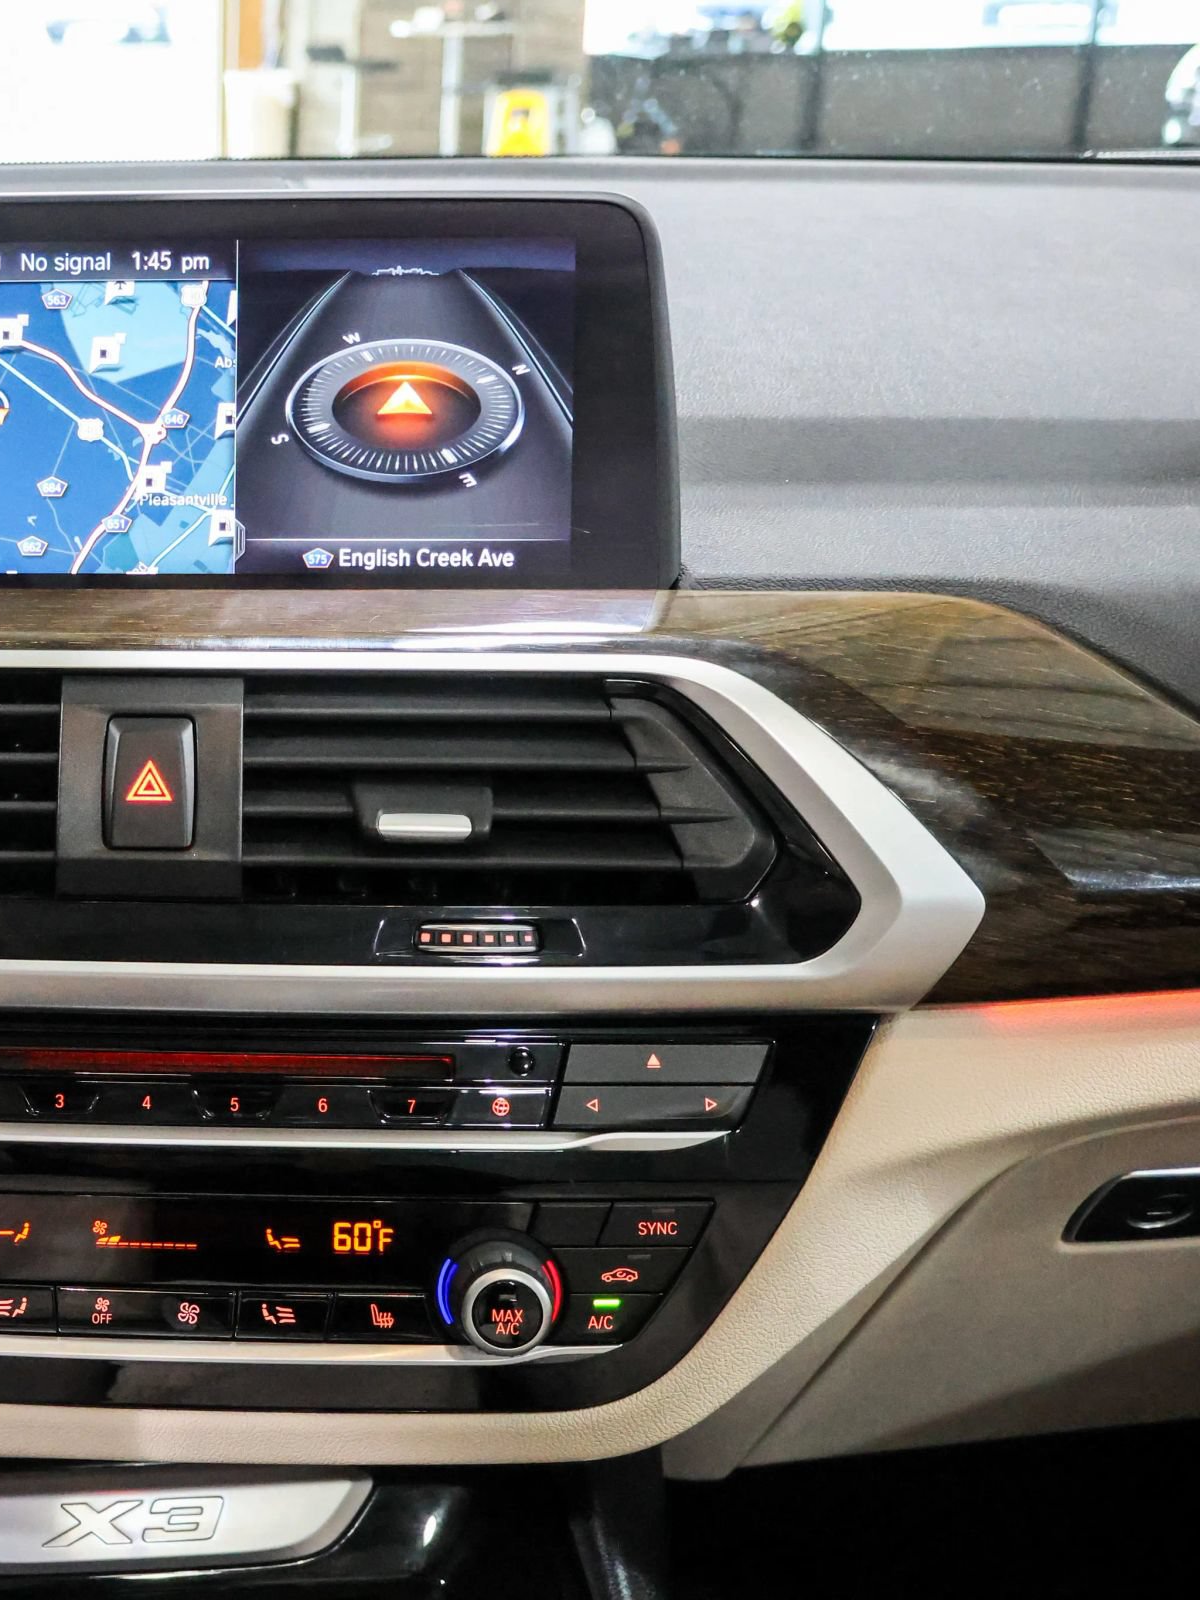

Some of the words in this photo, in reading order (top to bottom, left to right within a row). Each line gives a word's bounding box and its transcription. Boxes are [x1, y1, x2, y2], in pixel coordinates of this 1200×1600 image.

[21, 253, 48, 272] No
[54, 252, 111, 275] signal
[132, 251, 172, 271] 1:45
[181, 255, 210, 274] pm
[343, 331, 362, 346] W
[511, 363, 531, 376] N
[271, 433, 290, 446] S
[458, 472, 478, 488] E
[139, 493, 228, 507] Pleasantville
[307, 553, 328, 565] 575
[338, 547, 411, 571] English
[416, 547, 474, 568] Creek
[477, 547, 515, 568] Ave
[54, 1093, 65, 1109] 3
[141, 1095, 151, 1110] 4
[229, 1096, 240, 1112] 5
[317, 1097, 328, 1112] 6
[406, 1098, 417, 1114] 7
[332, 1219, 395, 1252] 60°F
[638, 1221, 678, 1236] SYNC
[91, 1313, 113, 1325] OFF
[491, 1309, 524, 1323] MAX
[588, 1315, 614, 1331] A/C
[495, 1322, 520, 1336] A/C
[41, 1495, 224, 1548] X3
